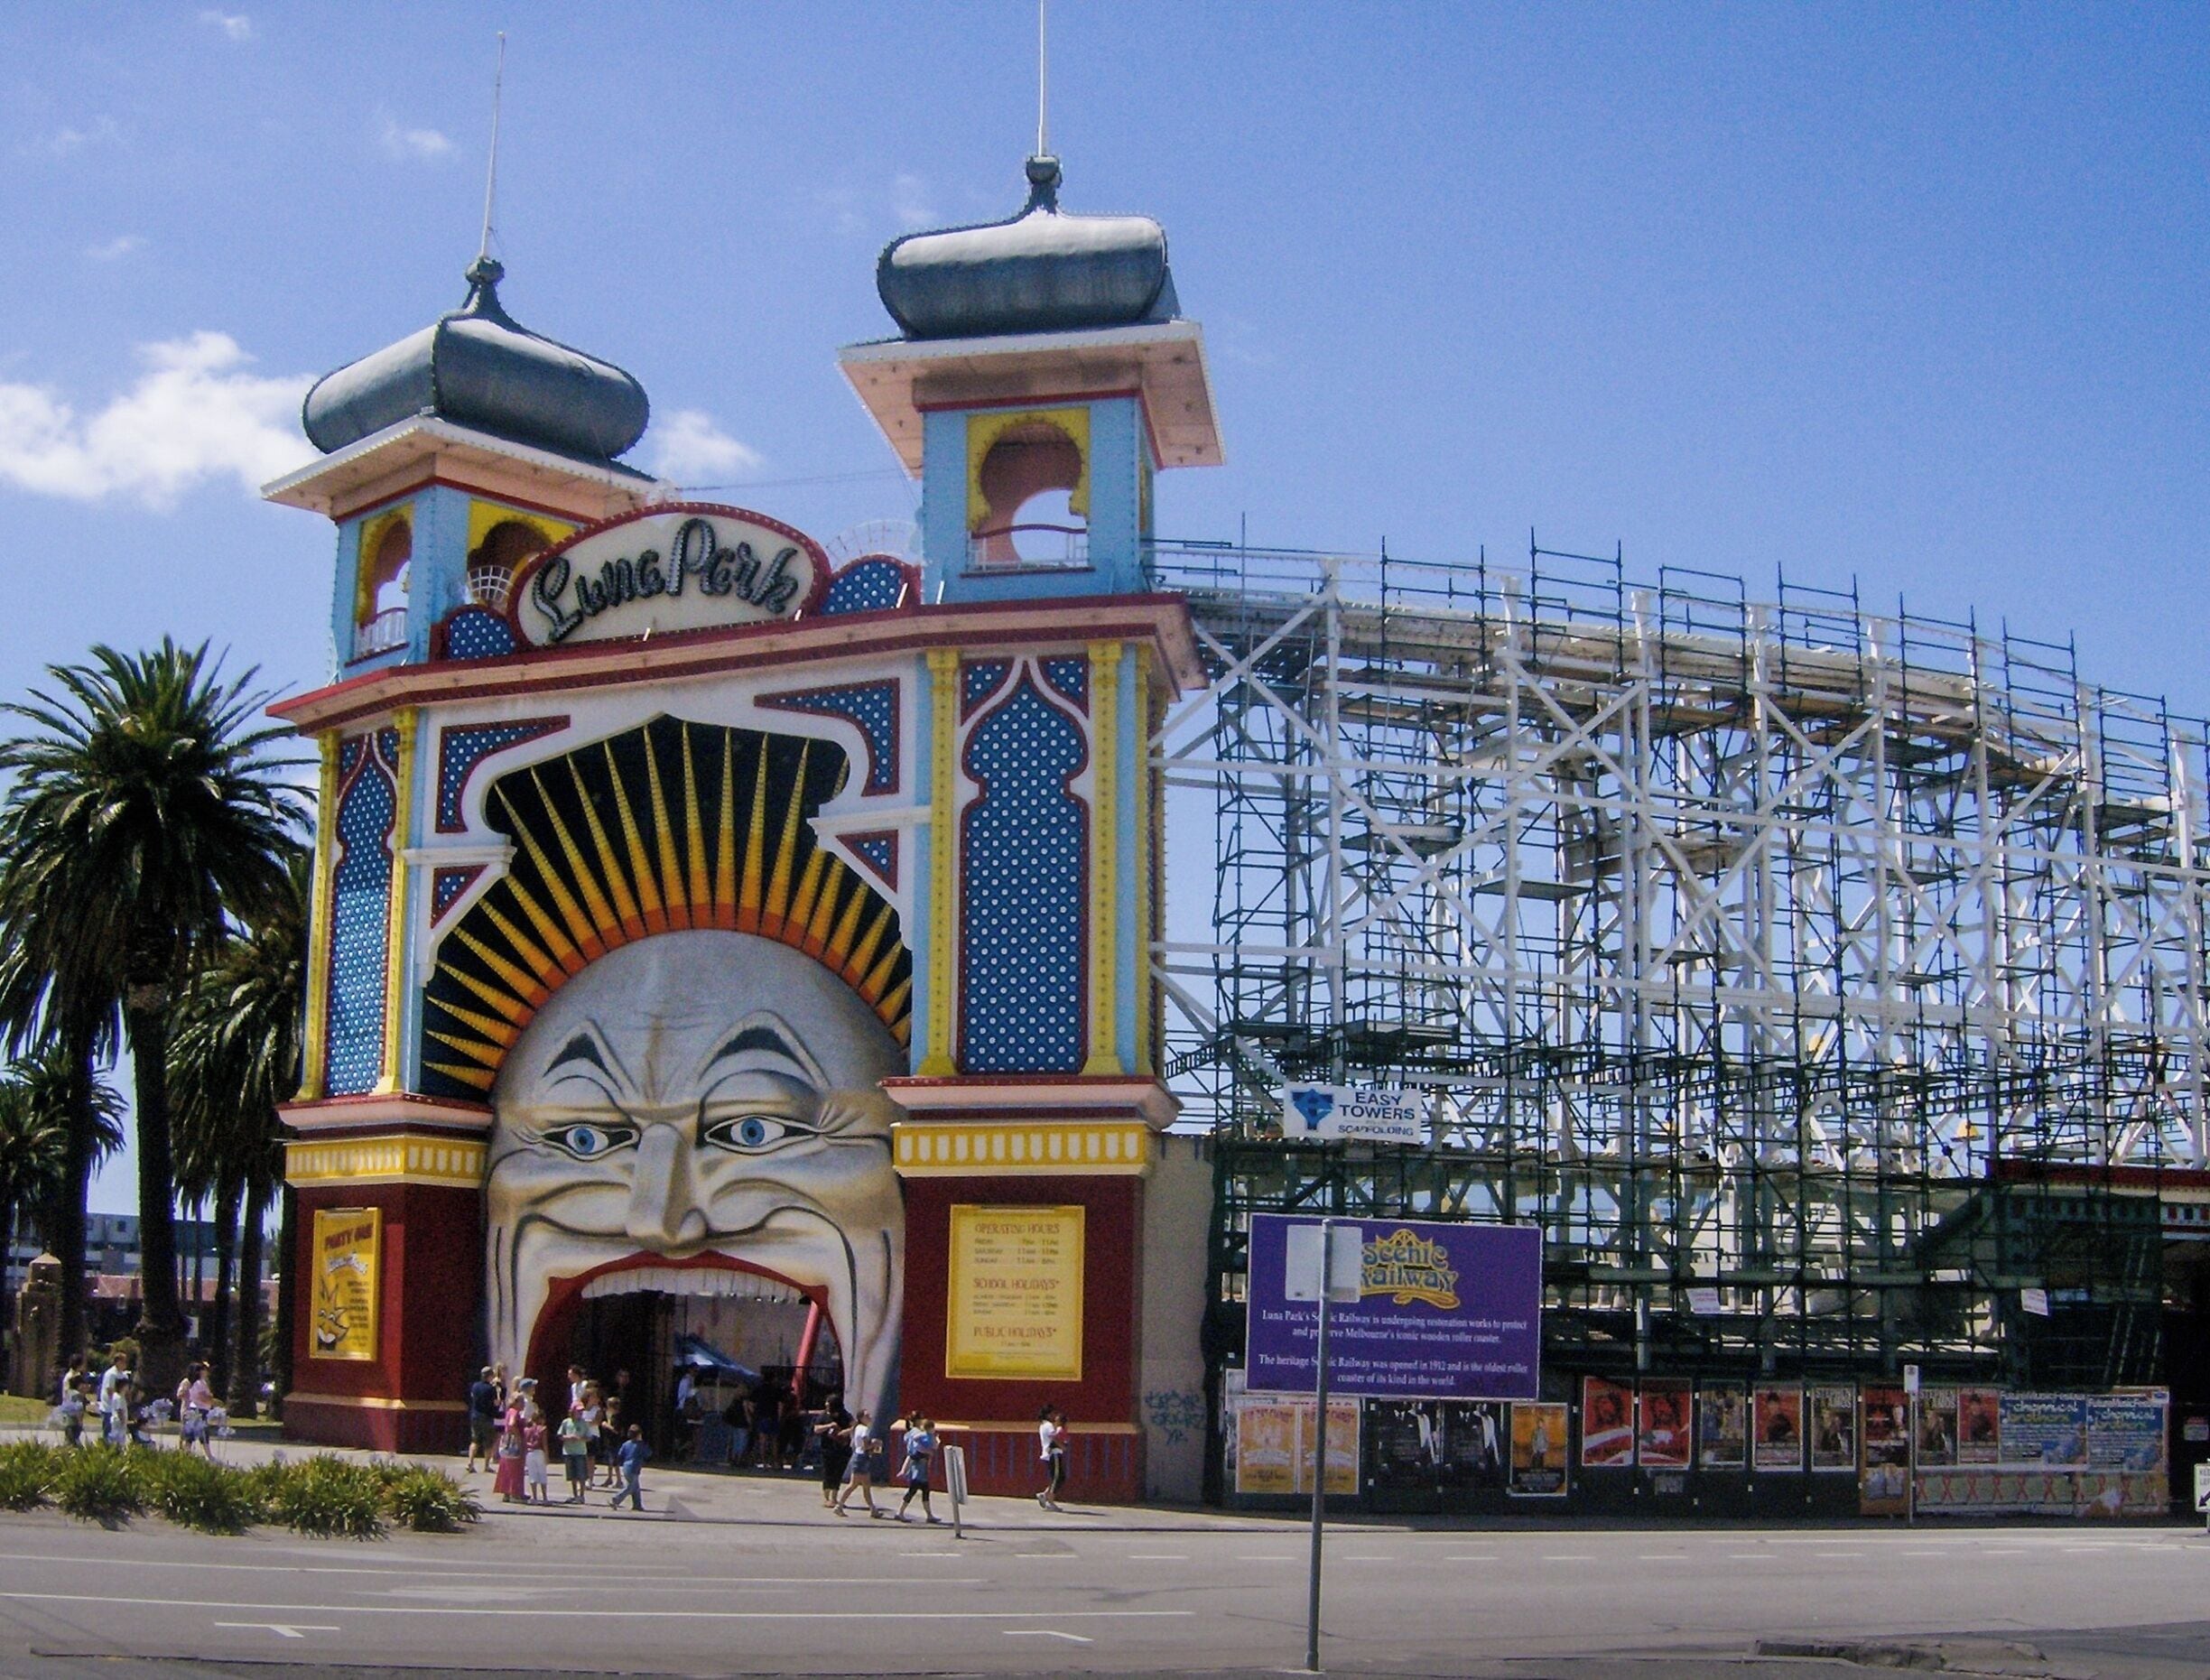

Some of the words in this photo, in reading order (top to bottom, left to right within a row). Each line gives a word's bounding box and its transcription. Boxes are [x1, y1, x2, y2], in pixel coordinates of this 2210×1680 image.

[533, 548, 666, 642] Luna
[666, 517, 799, 614] Park
[1355, 1092, 1402, 1106] EASY
[1339, 1104, 1416, 1120] TOWERS
[1338, 1125, 1414, 1137] SCAFFOLDING
[1027, 1223, 1060, 1235] HOURS
[1361, 1243, 1449, 1271] Scenic
[1262, 1309, 1283, 1321] Luna
[1285, 1310, 1310, 1322] Park's
[1339, 1313, 1371, 1329] Railway
[1372, 1314, 1379, 1324] is
[1380, 1313, 1425, 1330] undergoing
[1426, 1317, 1468, 1328] restoration
[1469, 1318, 1491, 1329] works
[1492, 1319, 1500, 1329] to
[1502, 1320, 1527, 1332] protect
[1292, 1325, 1308, 1337] and
[1345, 1328, 1395, 1340] Melbourne's
[1396, 1330, 1418, 1341] iconic
[1420, 1331, 1451, 1342] wooden
[1452, 1332, 1472, 1343] roller
[1258, 1354, 1275, 1365] The
[1277, 1354, 1310, 1369] heritage
[1338, 1357, 1370, 1371] Railway
[1372, 1360, 1388, 1369] was
[1389, 1360, 1418, 1372] opened
[1419, 1360, 1428, 1369] in
[1447, 1360, 1462, 1371] and
[1462, 1361, 1470, 1371] is
[1470, 1361, 1483, 1372] the
[1484, 1362, 1507, 1373] oldest
[1508, 1362, 1528, 1374] roller
[1337, 1373, 1365, 1383] coaster
[1365, 1372, 1376, 1384] of
[1377, 1373, 1387, 1384] its
[1388, 1374, 1407, 1385] kind
[1408, 1374, 1416, 1385] in
[1417, 1374, 1430, 1385] the
